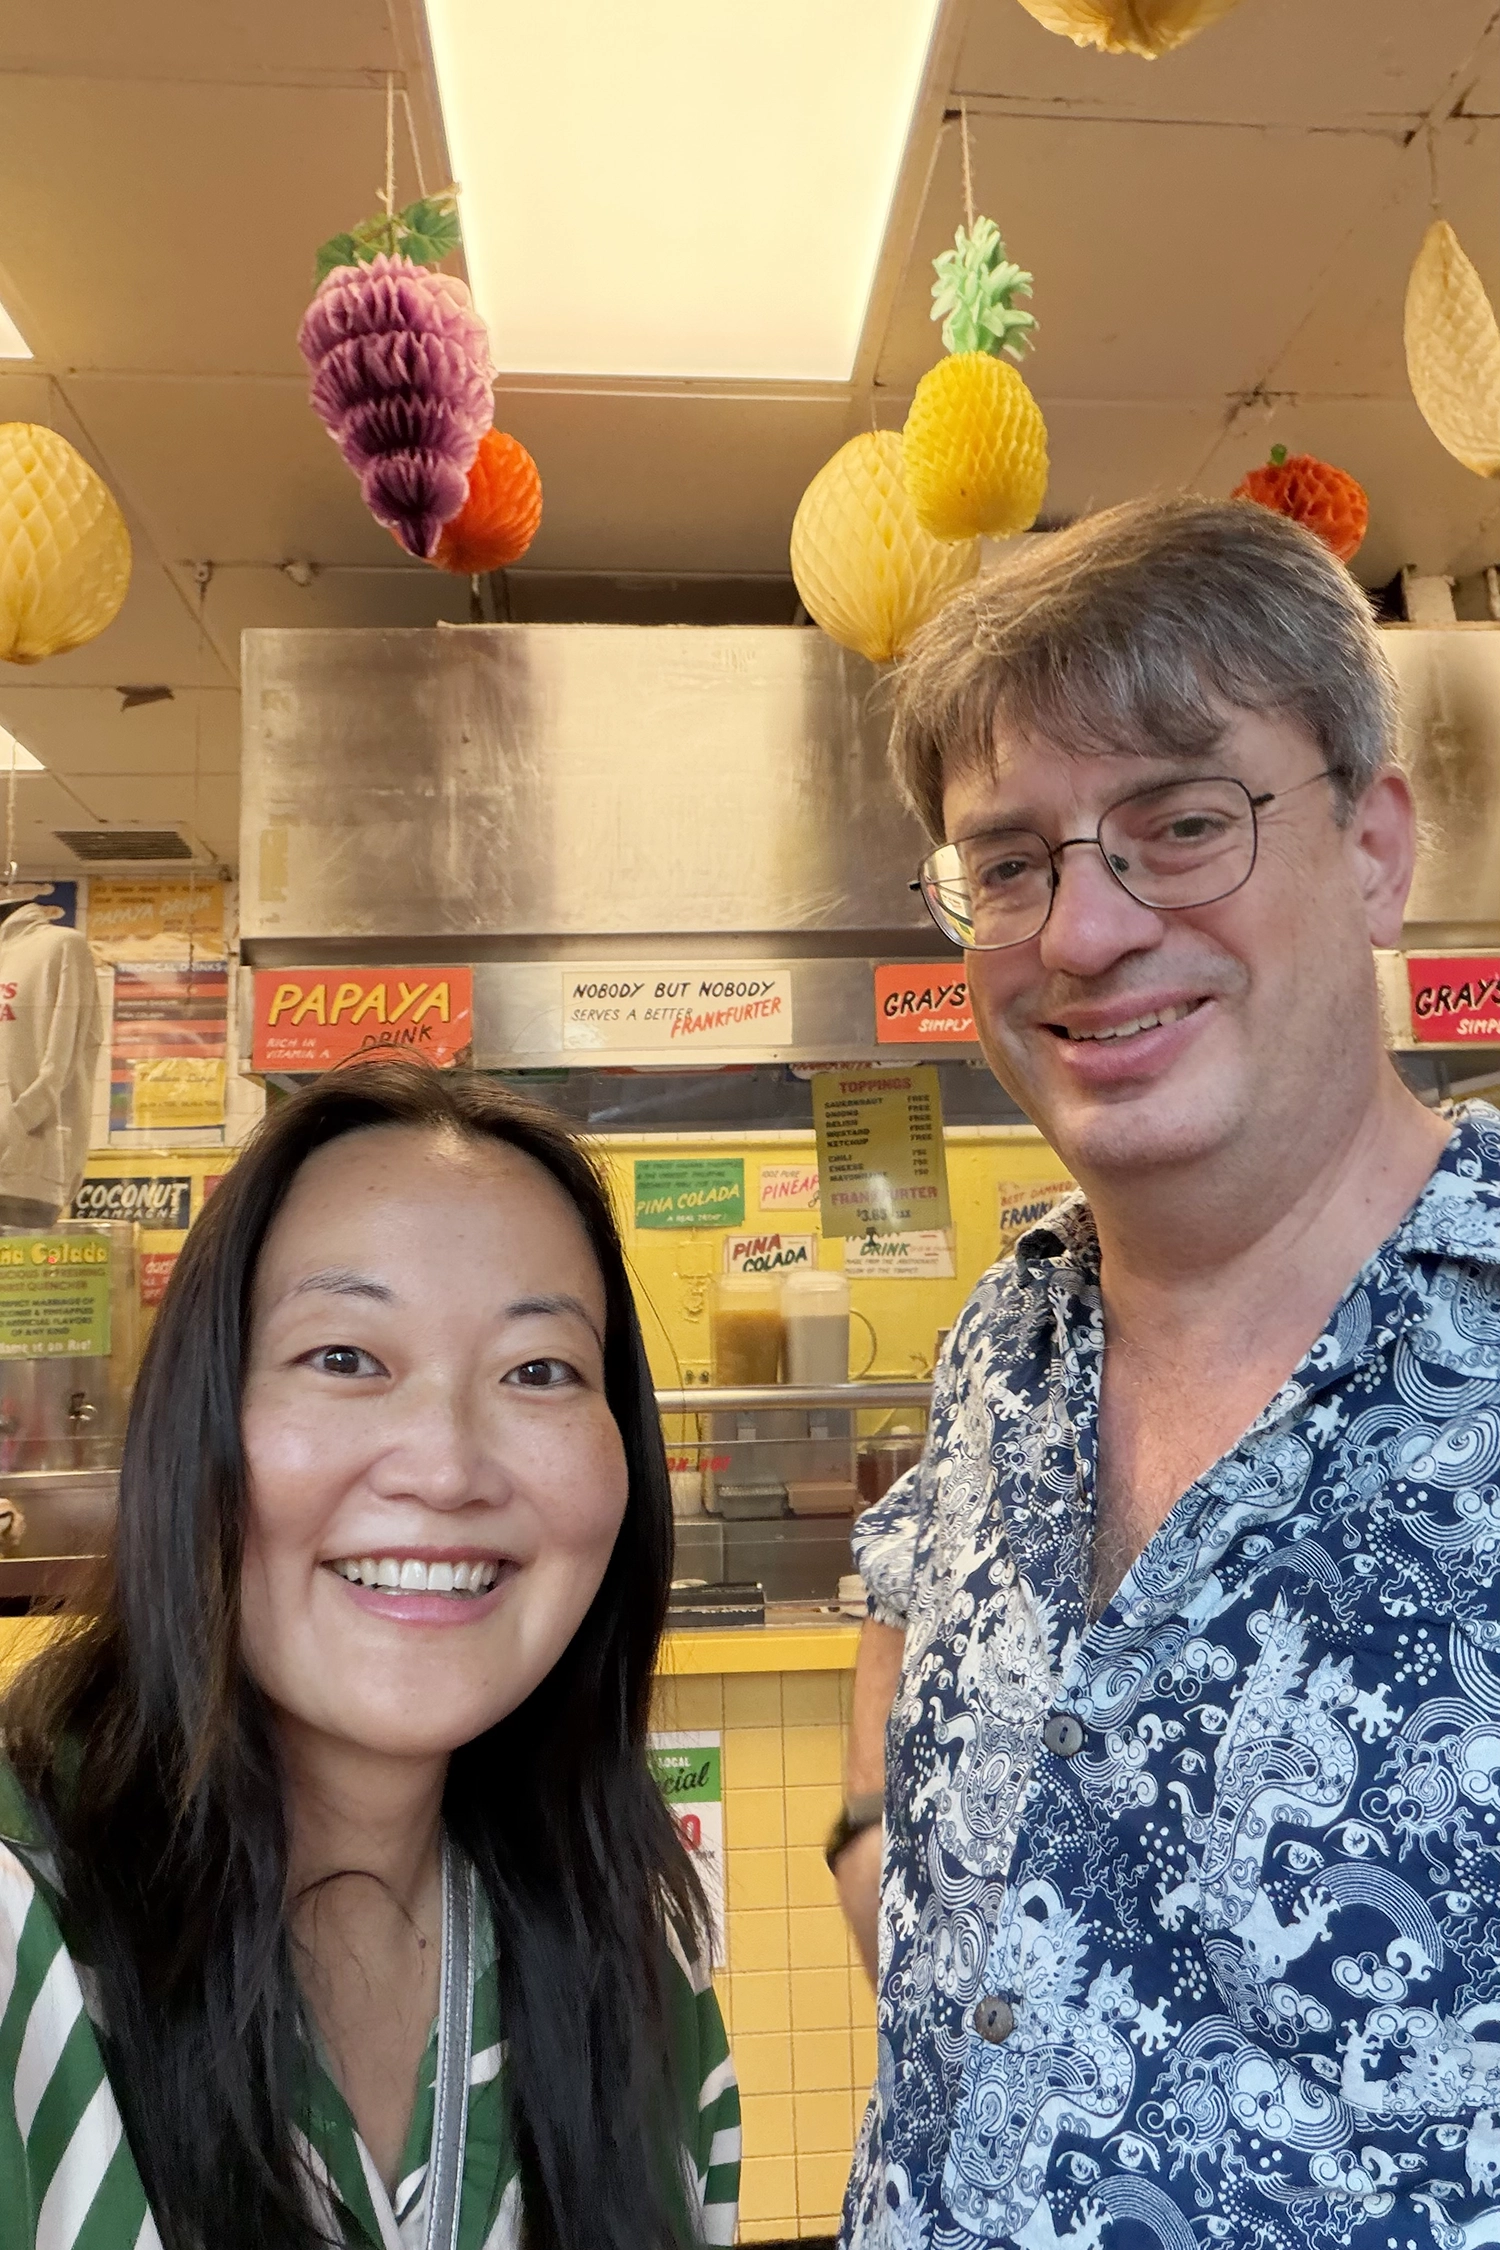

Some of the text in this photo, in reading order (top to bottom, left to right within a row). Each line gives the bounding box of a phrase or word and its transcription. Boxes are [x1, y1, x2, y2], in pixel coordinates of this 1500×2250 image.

[572, 981, 776, 999] NOBODY BUT NOBODY
[267, 982, 450, 1026] PAPAYA
[571, 1008, 693, 1021] SERVES A BETTER
[670, 996, 782, 1038] FRANKFURTER
[918, 1017, 972, 1032] SIMPLY
[266, 1038, 317, 1048] RICH IN
[361, 1024, 433, 1047] DRINK
[266, 1050, 330, 1059] VITAMIN A
[839, 1077, 912, 1094] TOPPINGS
[824, 1097, 884, 1108] SAUERKRAUT
[825, 1104, 931, 1118] ONIONS FREE
[826, 1114, 931, 1128] RELISH FREE
[826, 1124, 932, 1138] MUSTARD FREE
[827, 1133, 932, 1148] KETCHUP FREE
[828, 1154, 852, 1163] CHILI
[829, 1163, 864, 1172] CHEESE
[762, 1174, 820, 1201] PINEAP
[76, 1183, 188, 1209] COCONUT
[636, 1184, 740, 1216] PINA COLADA
[831, 1186, 937, 1206] FRANKURTER
[1001, 1192, 1025, 1206] BEST
[76, 1208, 180, 1218] CHAMPAGNE
[1000, 1199, 1053, 1230] FRANK
[31, 1242, 107, 1265] Colada
[733, 1234, 781, 1260] PINA
[860, 1242, 910, 1256] DRINK
[743, 1246, 807, 1272] COLADA
[658, 1757, 691, 1768] LOCAL
[659, 1762, 710, 1795] cial
